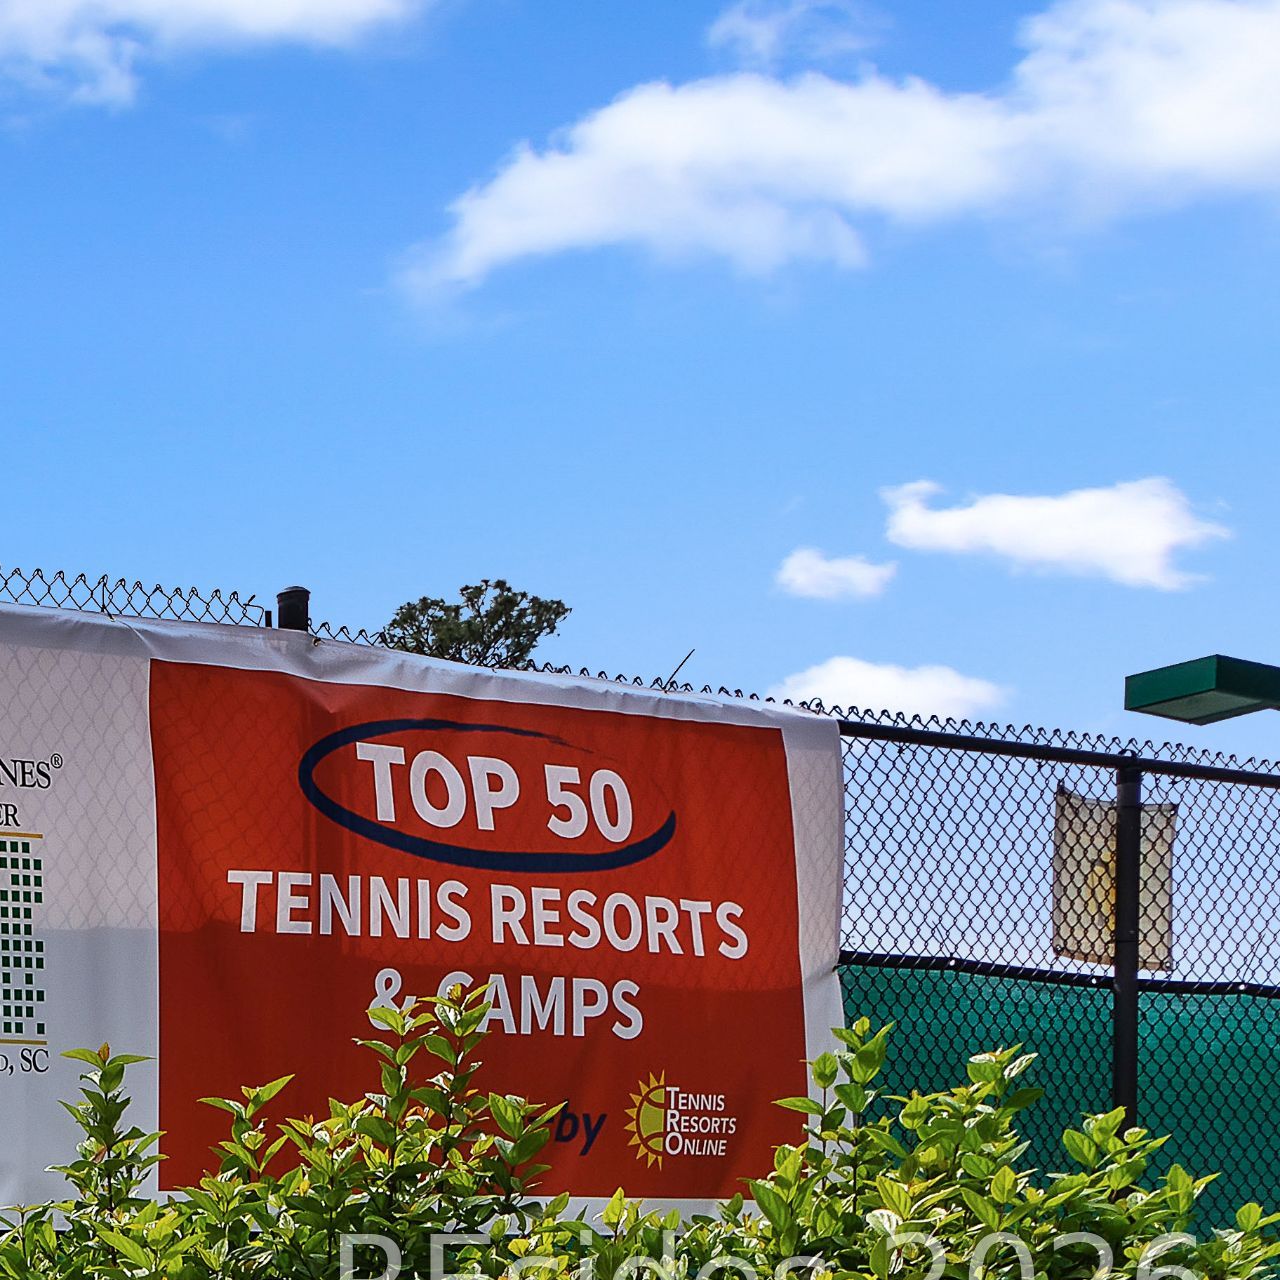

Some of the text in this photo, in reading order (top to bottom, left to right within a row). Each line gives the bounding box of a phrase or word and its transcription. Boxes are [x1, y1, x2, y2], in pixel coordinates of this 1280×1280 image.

[355, 742, 633, 843] TOP 50
[227, 869, 748, 960] TENNIS RESORTS
[20, 1048, 50, 1073] SC
[666, 1087, 725, 1111] TENNIS
[554, 1099, 607, 1156] by
[666, 1109, 737, 1134] RESORTS
[665, 1132, 728, 1156] ONLINE
